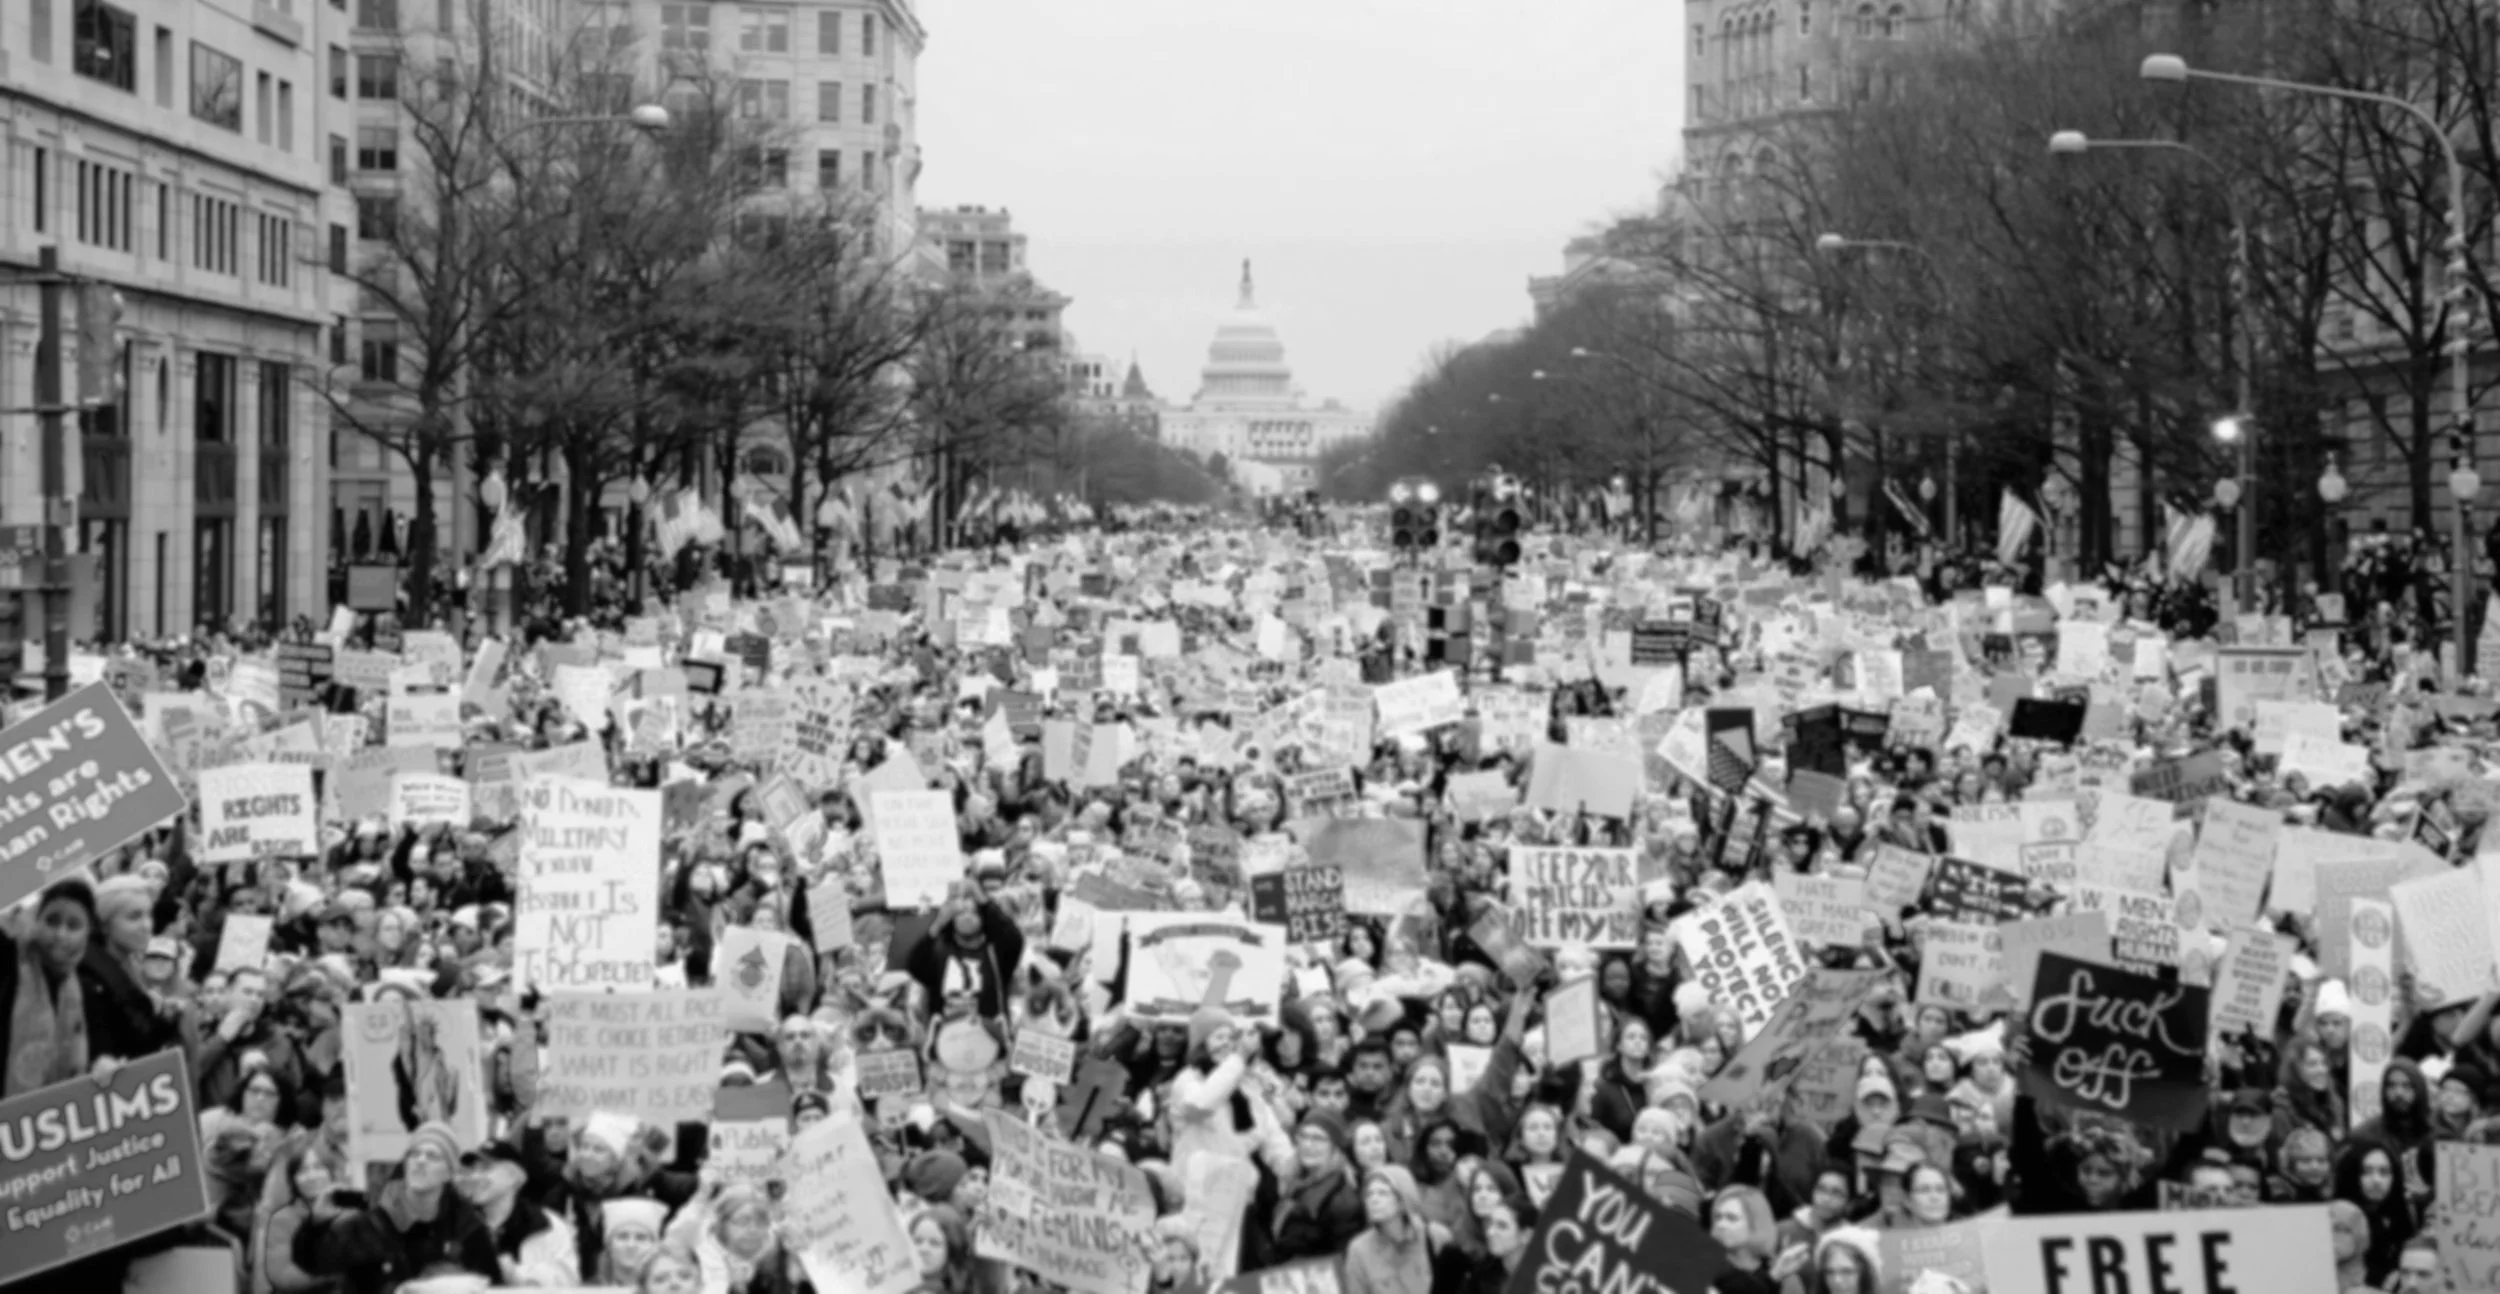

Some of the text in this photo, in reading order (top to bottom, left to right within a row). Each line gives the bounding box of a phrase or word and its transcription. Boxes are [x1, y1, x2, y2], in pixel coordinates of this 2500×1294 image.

[48, 759, 99, 797] are
[48, 767, 152, 830] Rights
[222, 793, 301, 820] RIGHTS
[208, 825, 249, 849] ARE
[1284, 866, 1342, 893] STAND
[548, 911, 607, 951] NOT
[1289, 908, 1349, 942] RISE
[1558, 910, 1607, 944] MY
[1719, 903, 1758, 959] WILL
[1699, 917, 1767, 1025] PROTECT
[589, 1000, 641, 1022] MUST
[555, 1025, 589, 1047] THE
[560, 1049, 712, 1078] WHAT IS RIGHT
[85, 1132, 165, 1171] Justice
[6, 1154, 182, 1232] Equality for All
[1576, 1169, 1653, 1255] YOU
[2037, 1230, 2240, 1294] FREE
